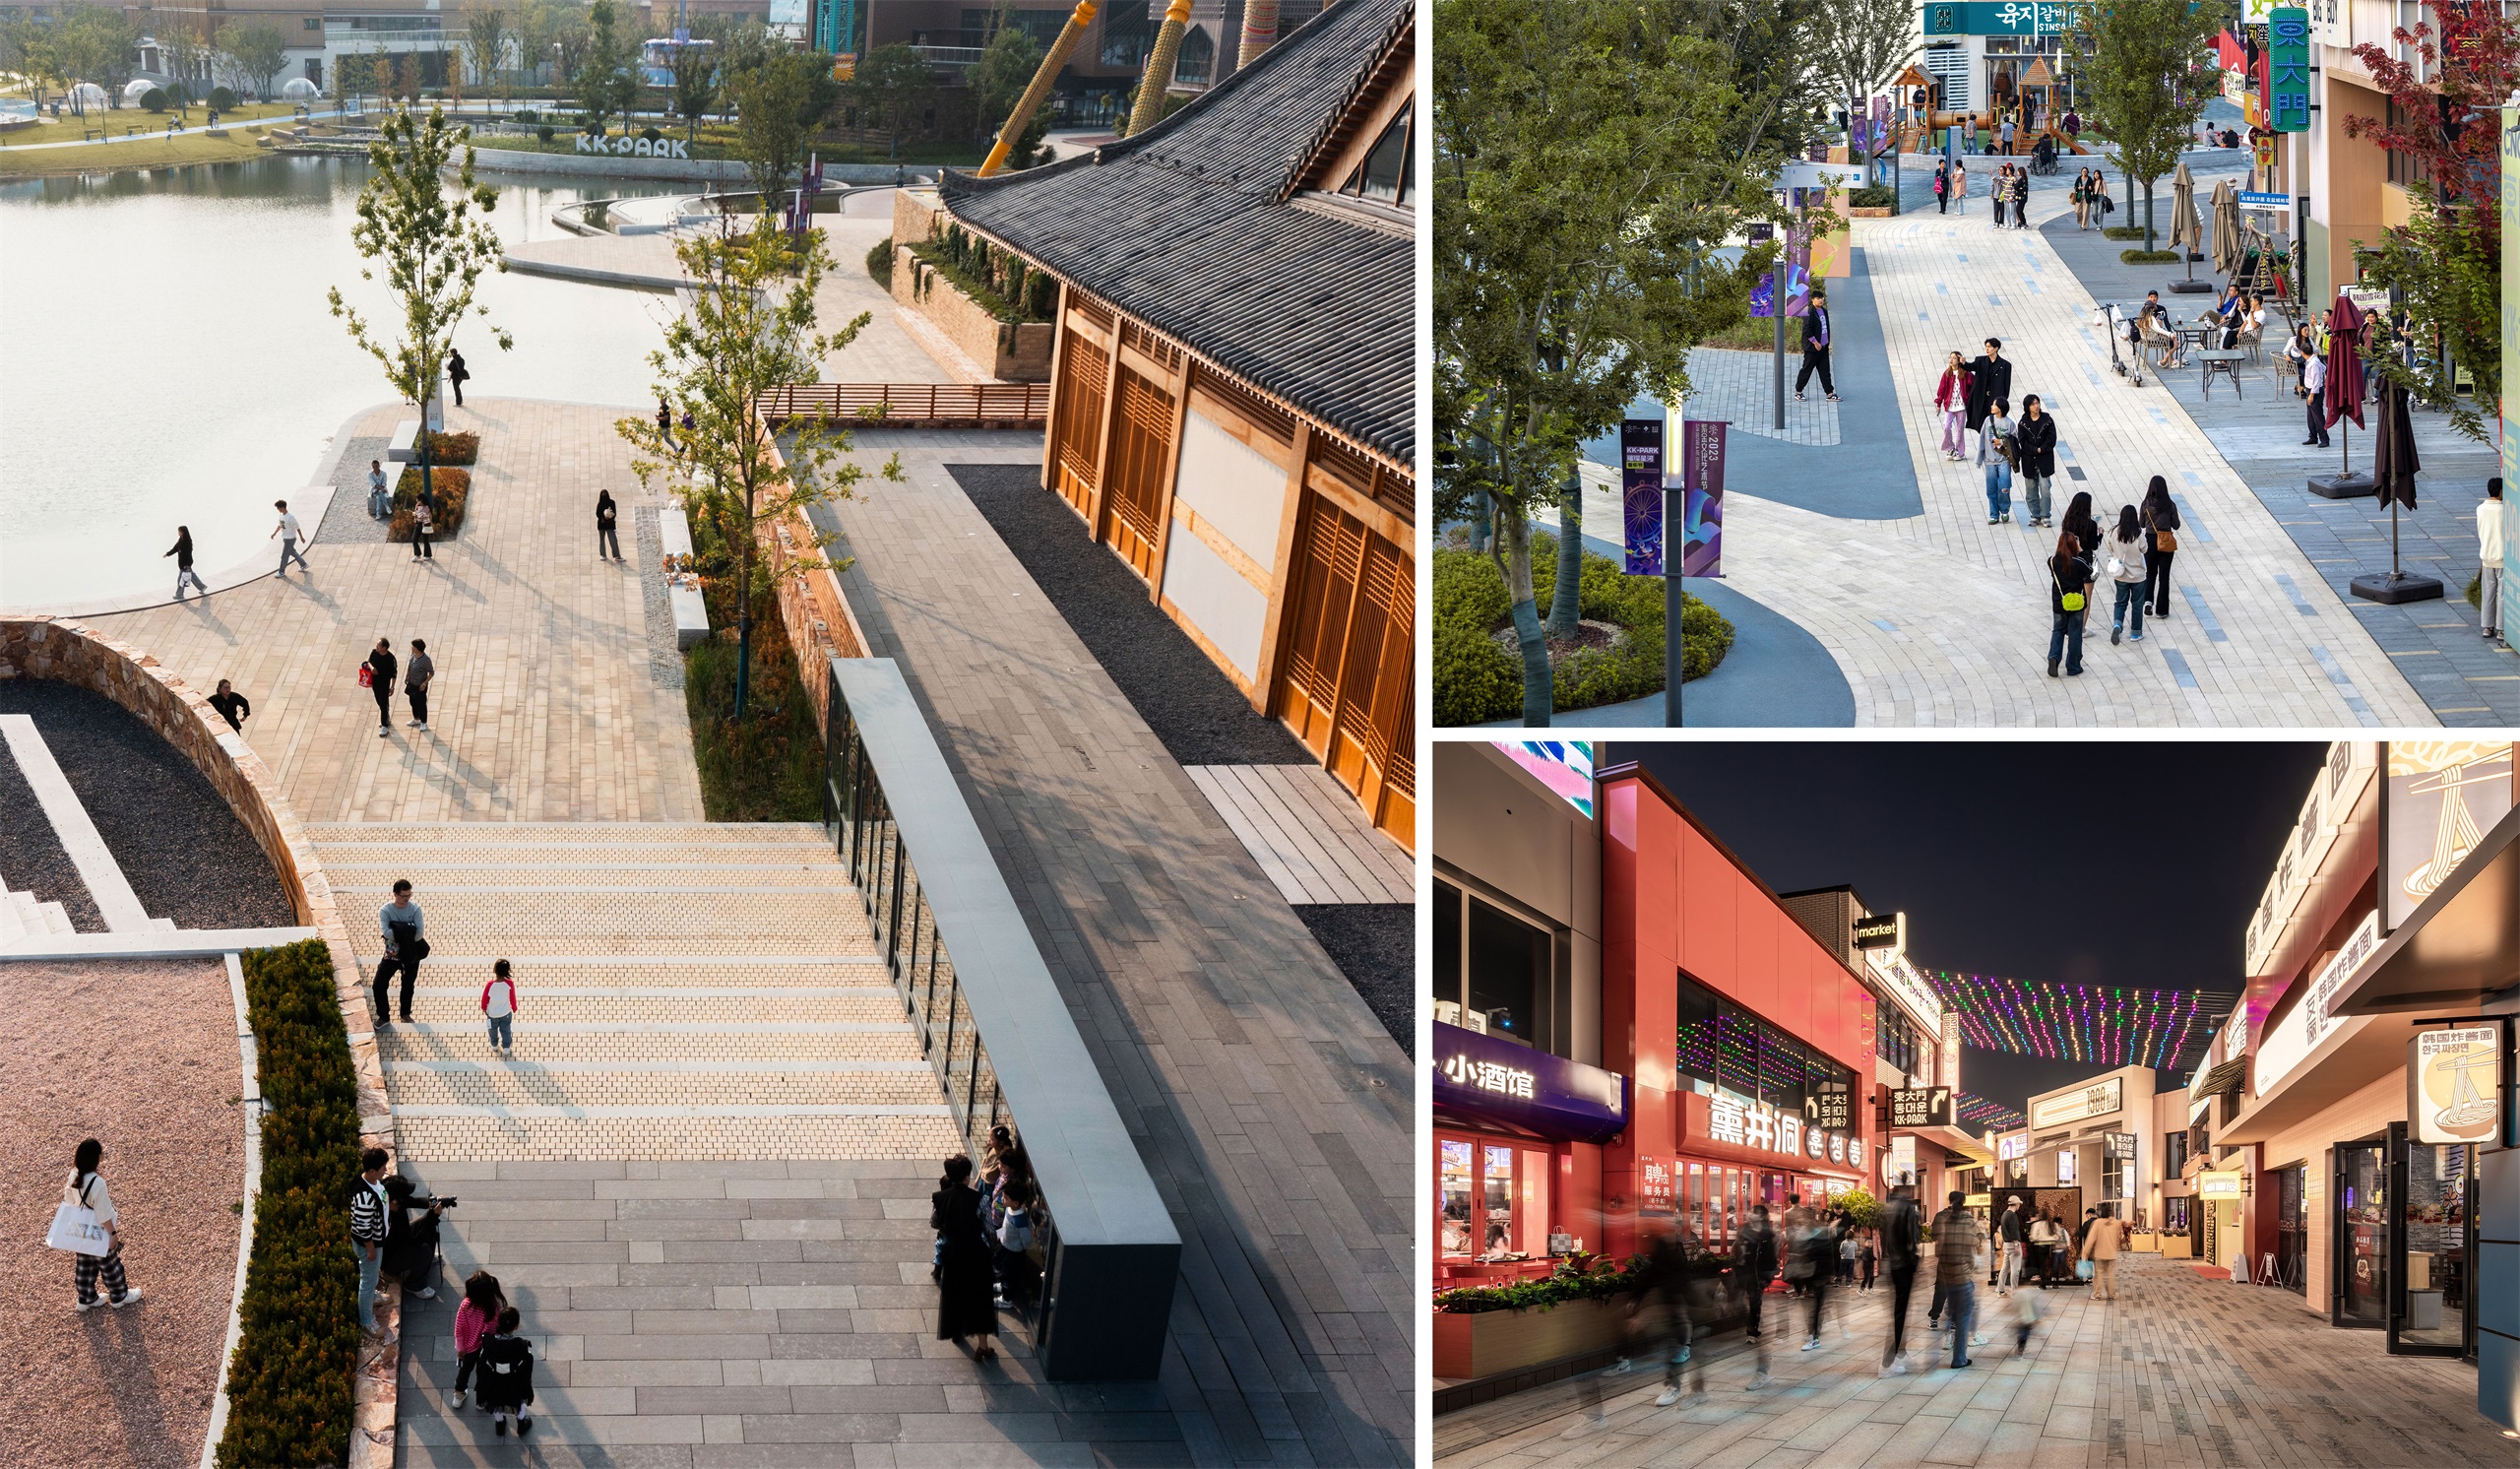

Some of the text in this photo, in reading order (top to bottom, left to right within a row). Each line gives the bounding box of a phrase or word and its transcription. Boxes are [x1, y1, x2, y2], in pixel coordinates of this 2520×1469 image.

[2276, 17, 2307, 125] 東大門
[1708, 437, 1719, 462] 2023
[1858, 922, 1897, 938] market
[2423, 1030, 2493, 1044] 韩国炸酱面
[1445, 1054, 1534, 1099] 小酒馆
[1894, 1090, 1927, 1103] 東大門
[1644, 1184, 1670, 1197] 服务员
